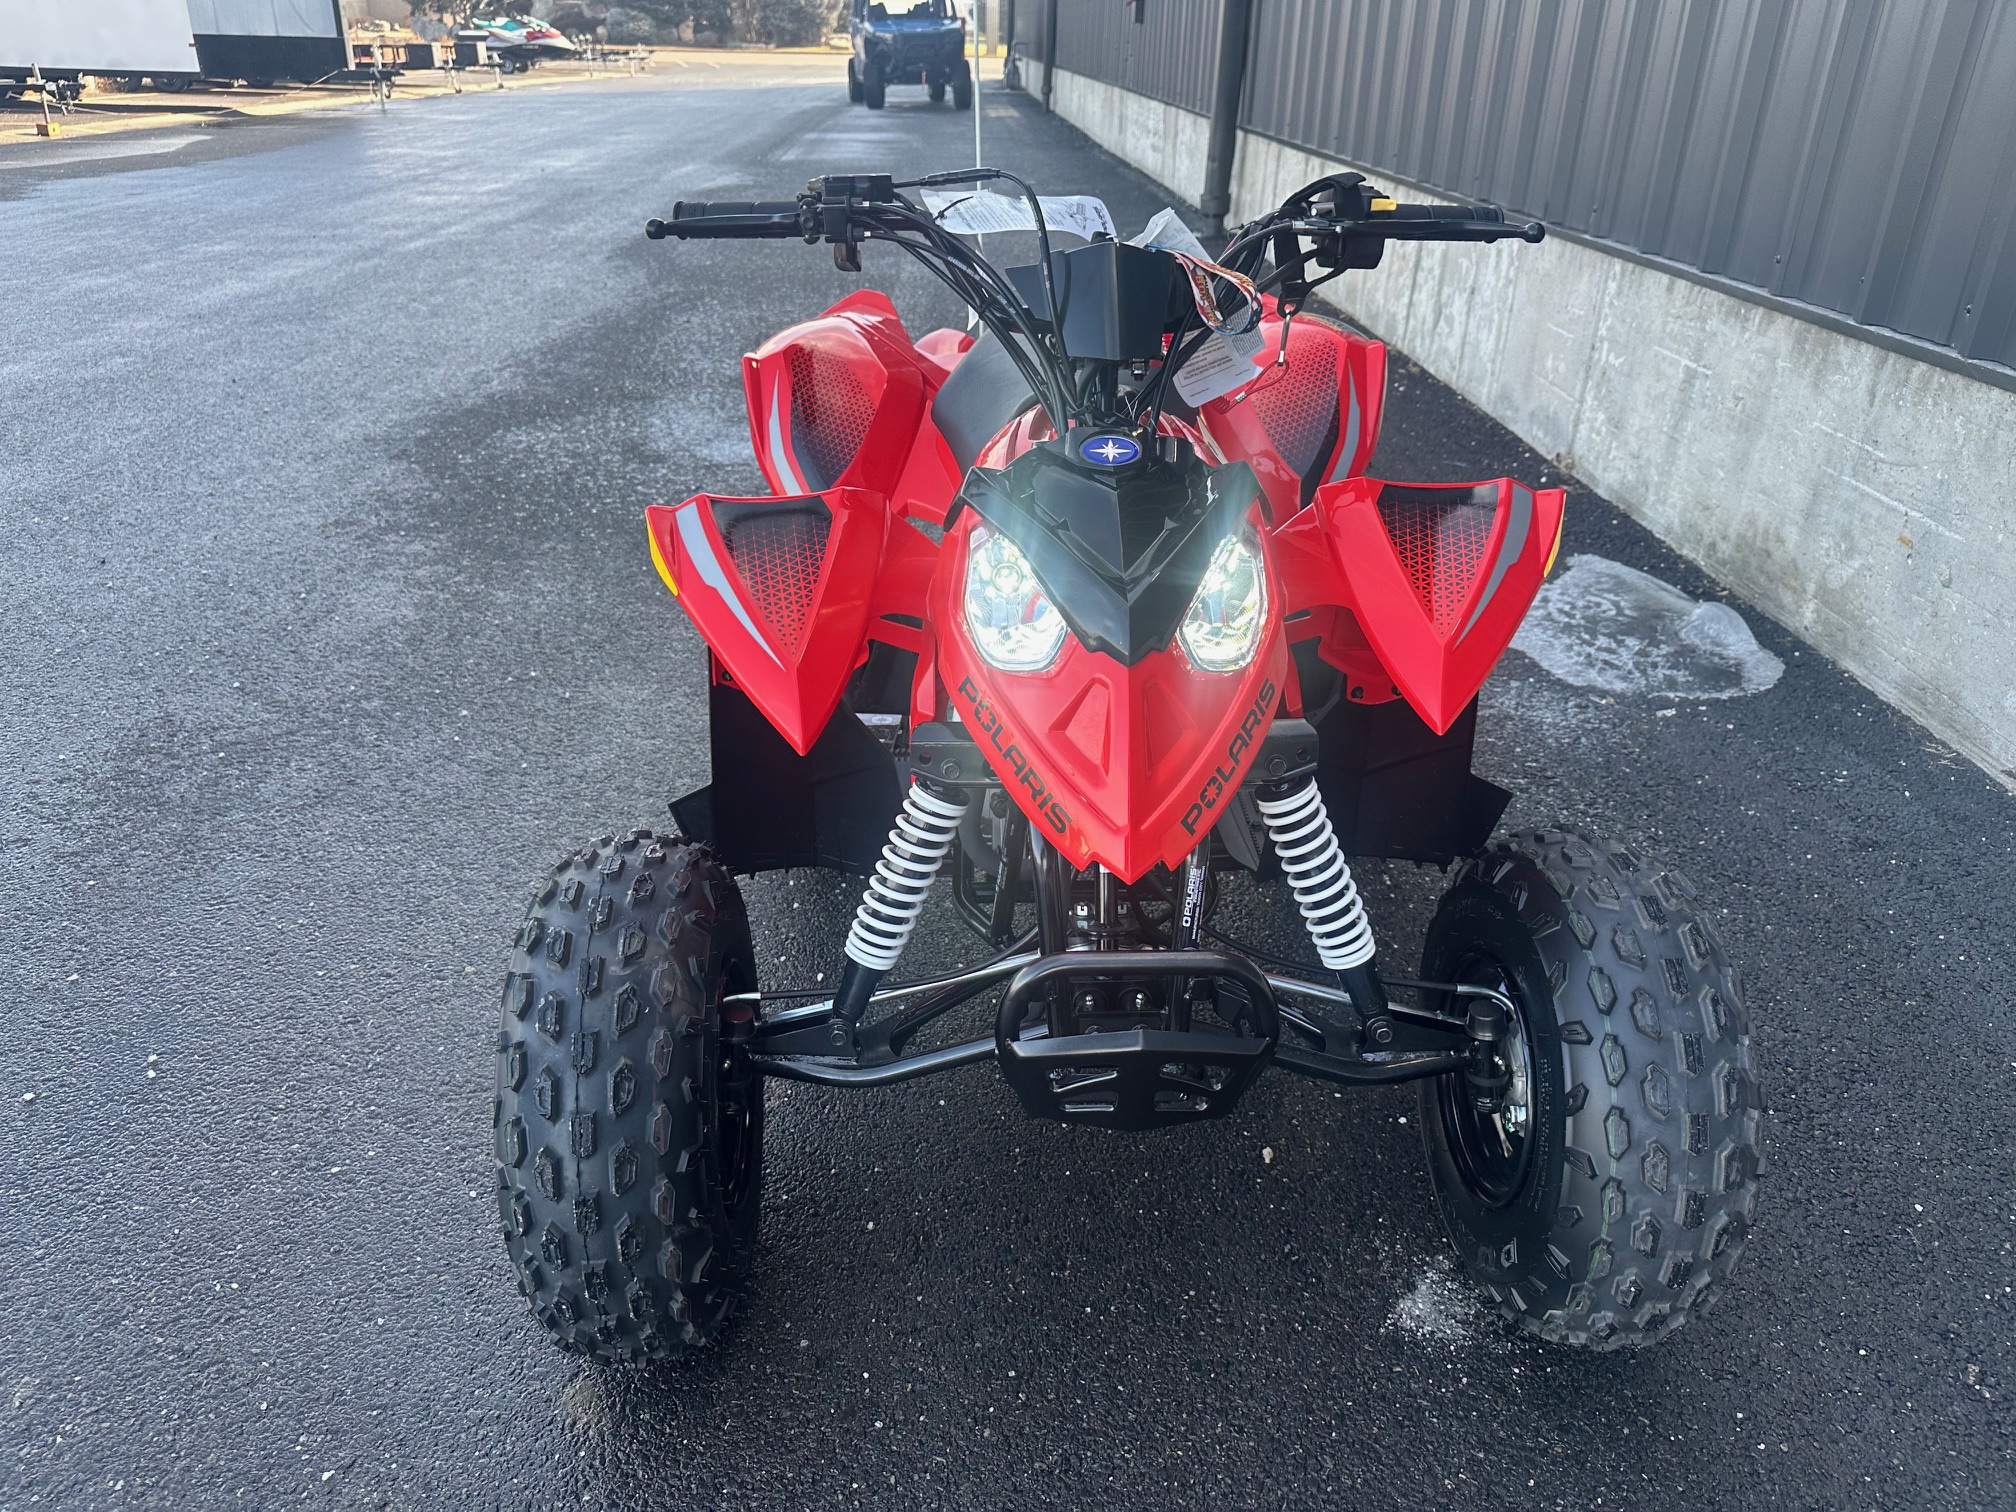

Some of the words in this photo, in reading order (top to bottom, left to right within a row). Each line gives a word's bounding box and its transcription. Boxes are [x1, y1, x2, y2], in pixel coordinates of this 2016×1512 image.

[958, 675, 1072, 834] POLARIS
[1180, 677, 1275, 836] POLARIS
[1184, 867, 1197, 916] POLARIS
